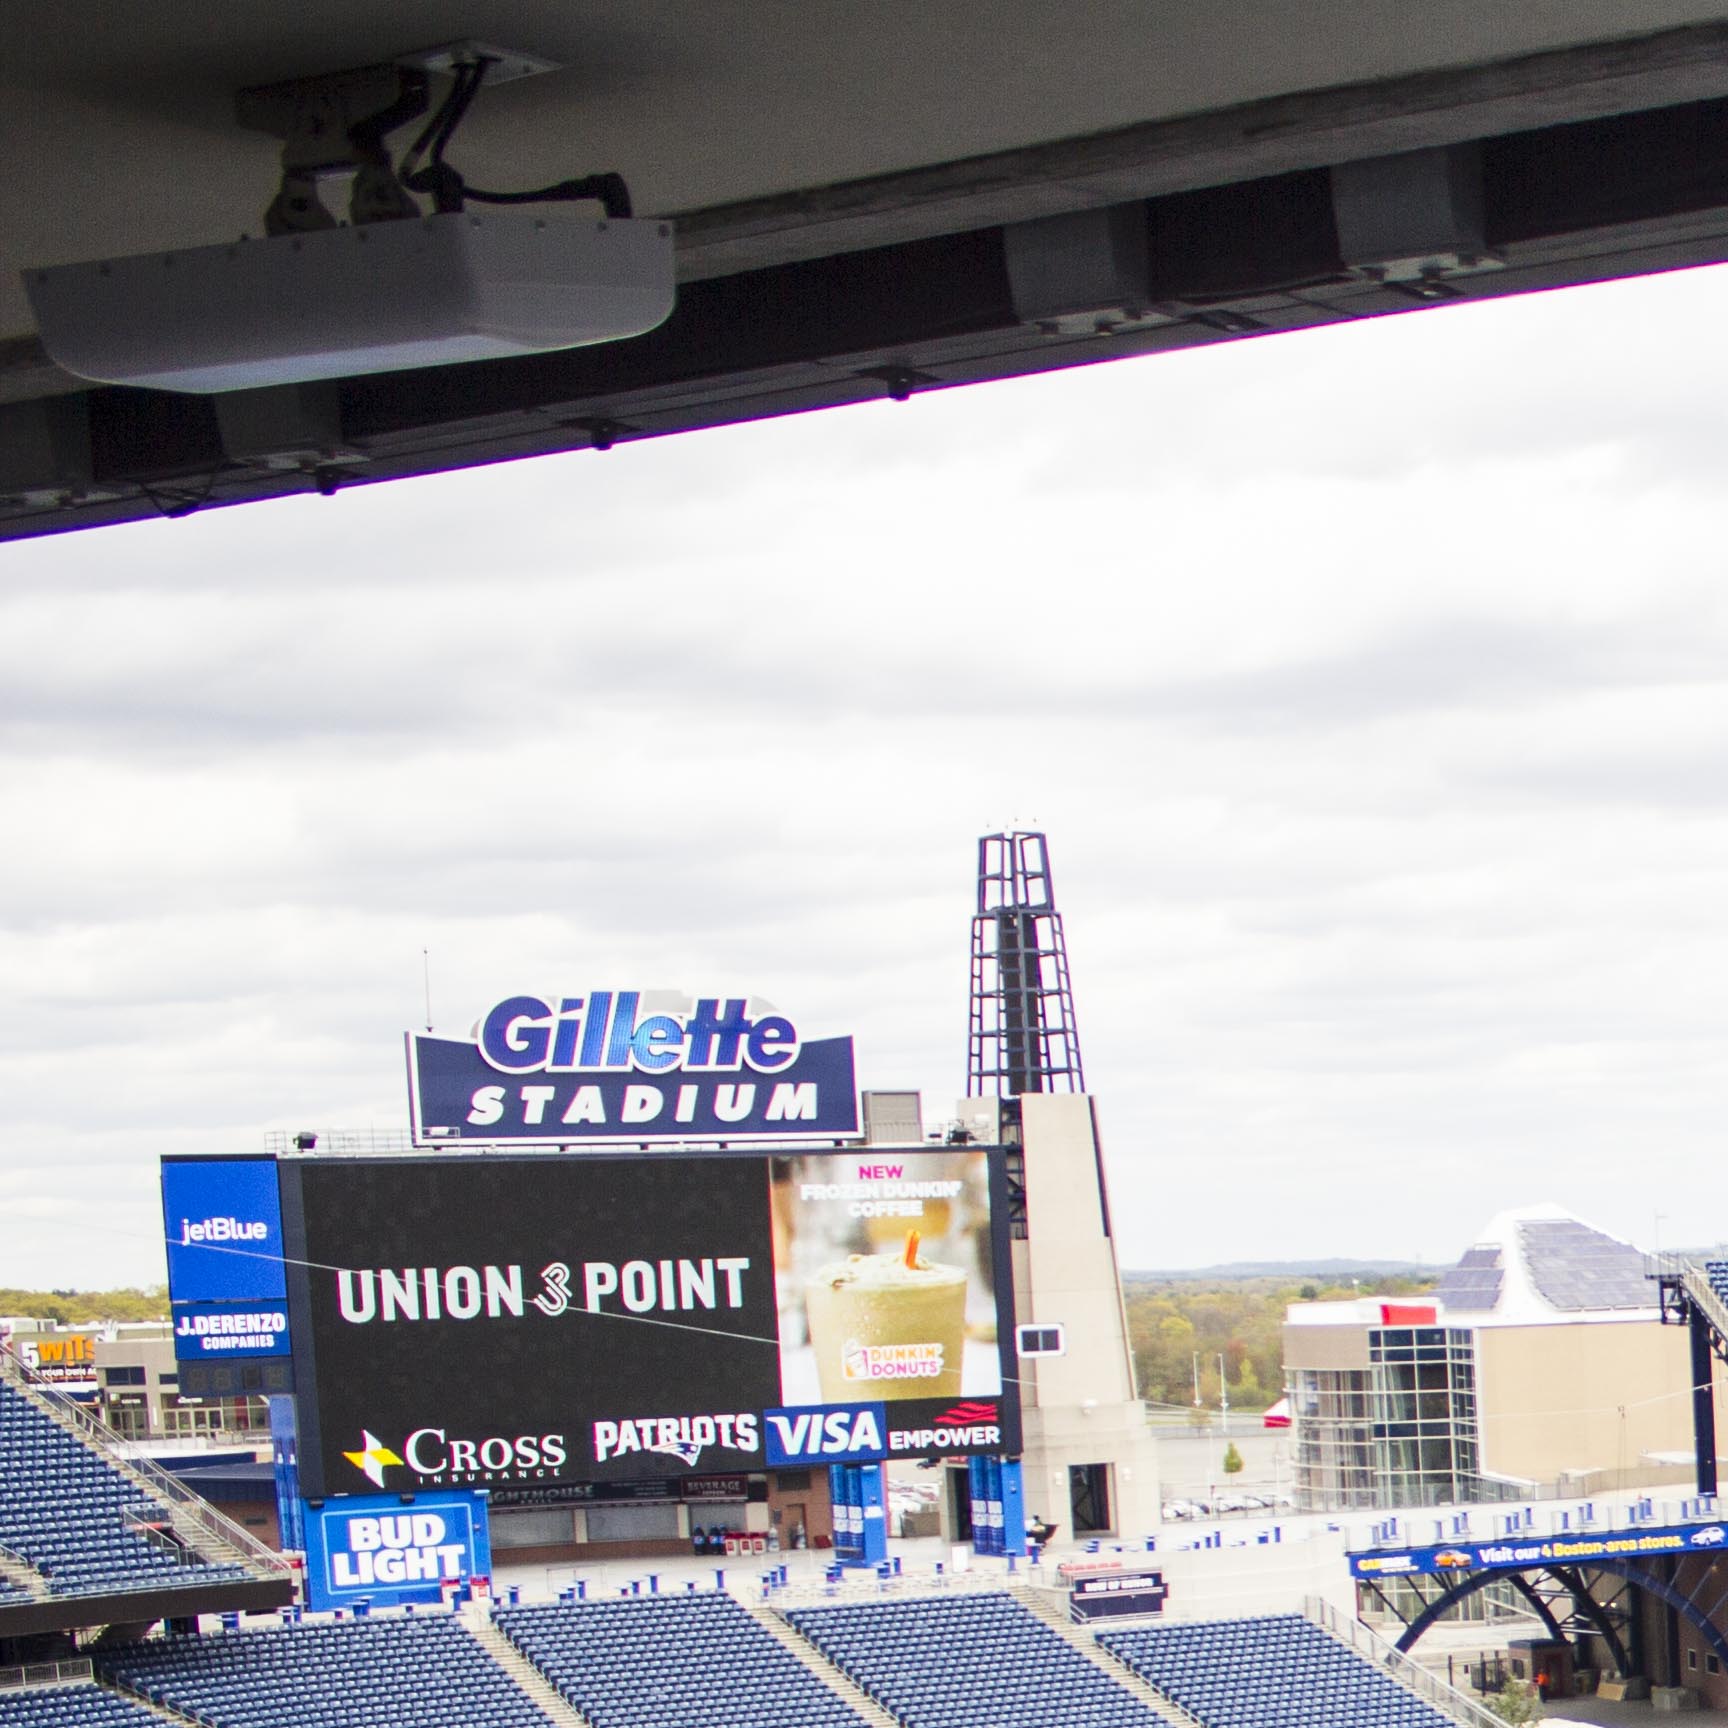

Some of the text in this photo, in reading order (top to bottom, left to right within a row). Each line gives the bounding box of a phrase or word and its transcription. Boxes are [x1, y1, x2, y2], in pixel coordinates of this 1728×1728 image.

[482, 991, 798, 1068] Gillette
[466, 1082, 818, 1125] STADIUM
[858, 1165, 904, 1180] NEW
[801, 1184, 880, 1200] FROZEN
[849, 1200, 924, 1217] COFFEE
[181, 1217, 268, 1247] jetBlue
[337, 1265, 524, 1324] UNION
[583, 1257, 751, 1314] POINT
[176, 1312, 286, 1336] J.DERENZO
[202, 1334, 275, 1350] COMPANIES
[871, 1360, 938, 1376] DONUTS
[593, 1411, 1001, 1463] PATRIOTS VISA EMPOWER
[419, 1467, 561, 1485] INSURANCE
[347, 1513, 447, 1552] BUD
[333, 1544, 466, 1587] LIGHT
[1479, 1547, 1512, 1564] Visit
[1514, 1547, 1541, 1561] our
